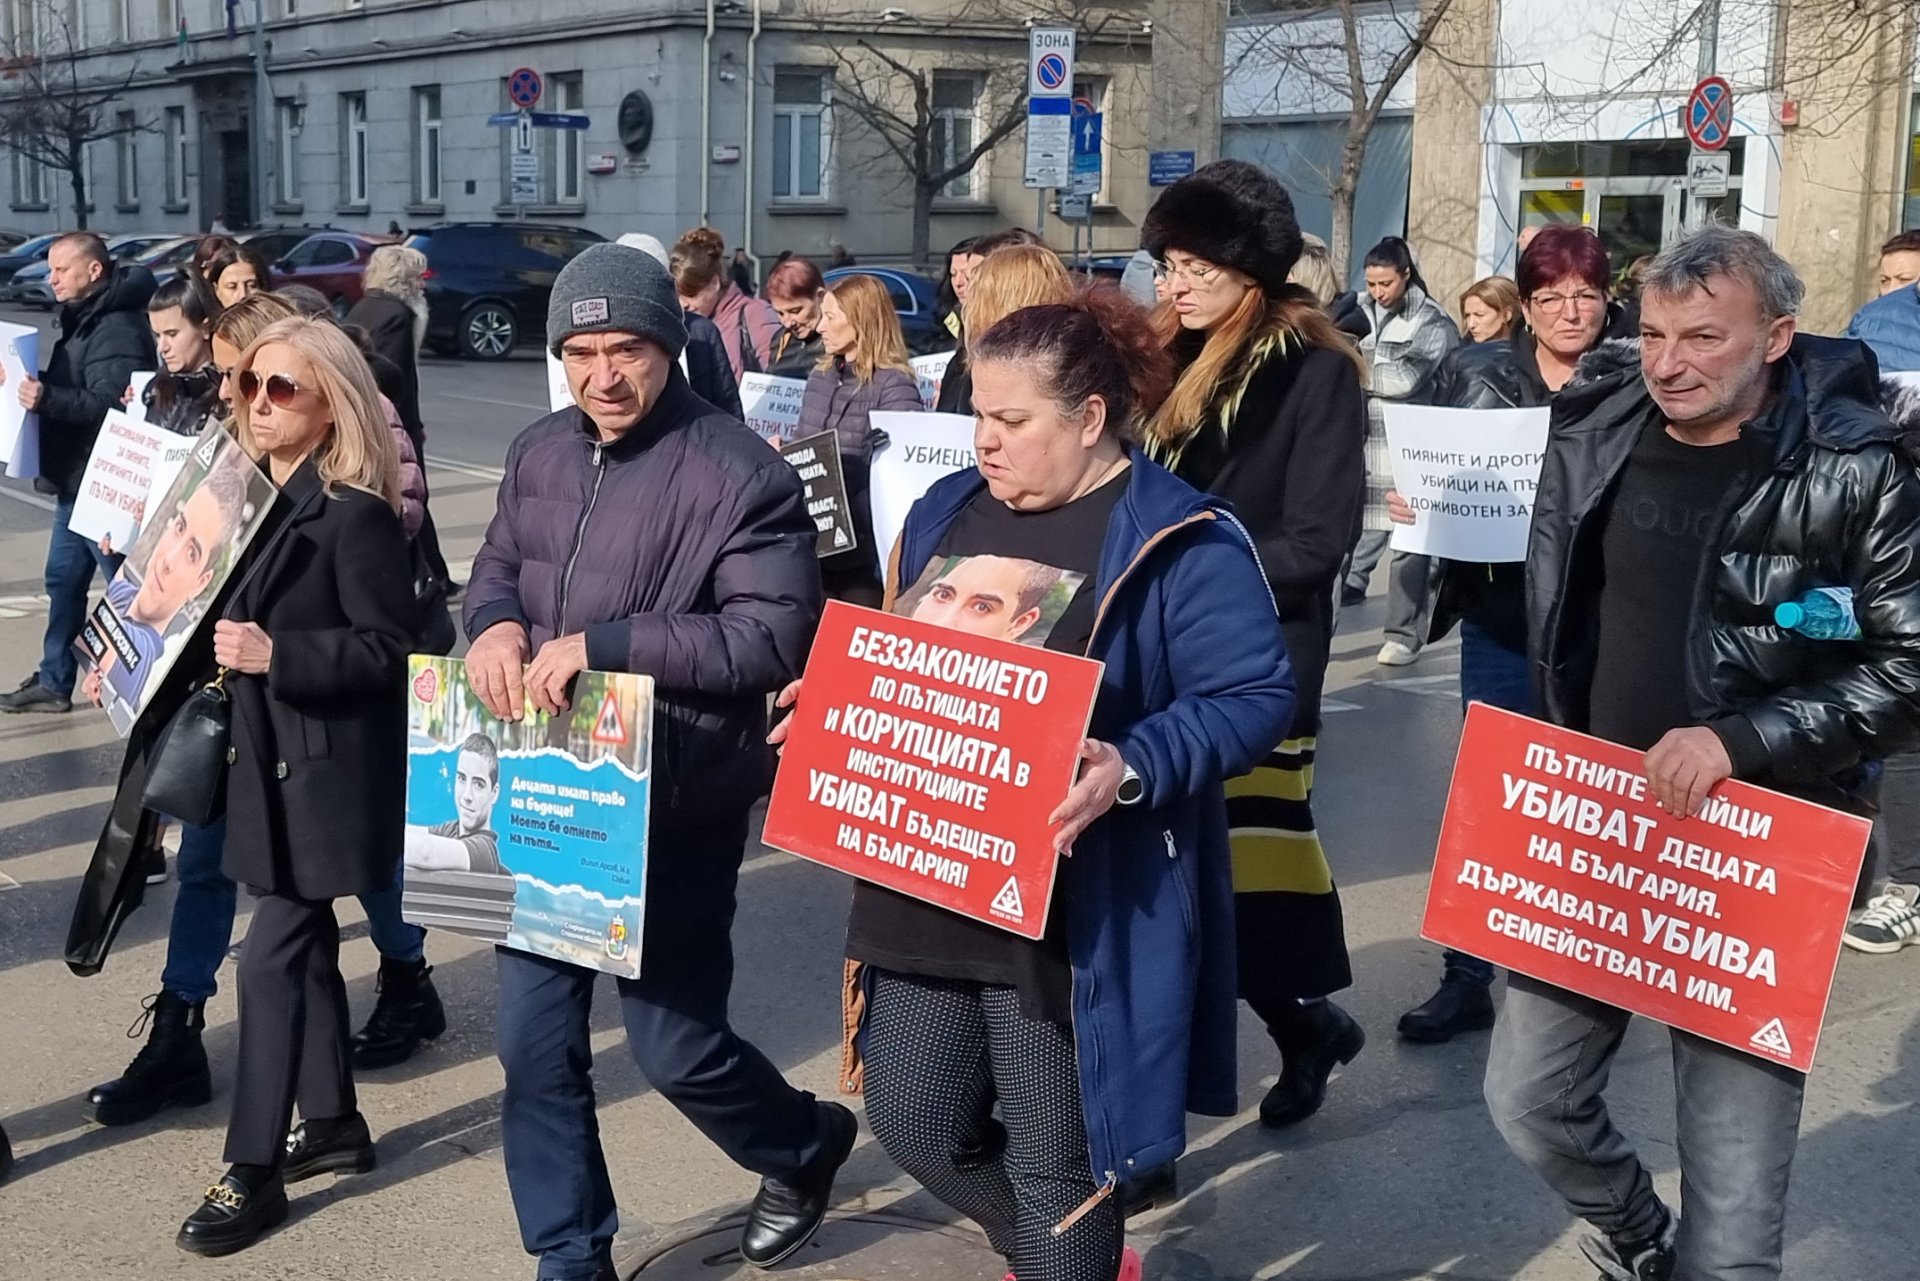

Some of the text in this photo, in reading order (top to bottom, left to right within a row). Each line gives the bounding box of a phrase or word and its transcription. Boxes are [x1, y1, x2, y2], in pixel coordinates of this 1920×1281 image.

[1035, 34, 1070, 48] ЗОНА
[904, 445, 976, 470] УБИЕЦЪ
[1402, 448, 1466, 467] ПИЯНИТЕ
[1470, 455, 1482, 468] И
[1420, 473, 1479, 495] УБИЙЦИ
[1484, 481, 1508, 493] НА
[1410, 497, 1501, 518] ДОЖИВОТЕН
[847, 626, 1048, 705] БЕЗЗАКОНИЕТО
[870, 676, 1000, 732] ПО ПЪТИЩАТА
[840, 704, 1010, 783] КОРУПЦИЯТА
[1524, 742, 1648, 803] ПЪТНИТЕ
[511, 777, 625, 806] Децата имат право
[511, 797, 574, 817] на бъдеще!
[846, 747, 989, 811] ИНСТИТУЦИИТЕ
[510, 814, 607, 841] Моето бе отнето
[510, 833, 521, 844] на
[807, 768, 1016, 866] УБИВАТ БЪДЕЩЕТО
[1502, 773, 1777, 895] УБИВАТ ДЕЦАТА
[836, 823, 969, 888] НА БЪЛГАРИЯ!
[1527, 834, 1722, 919] НА БЪЛГАРИЯ.
[1457, 859, 1777, 987] ДЪРЖАВАТА УБИВА
[1487, 908, 1738, 1014] СЕМЕЙСТВАТА ИМ.
